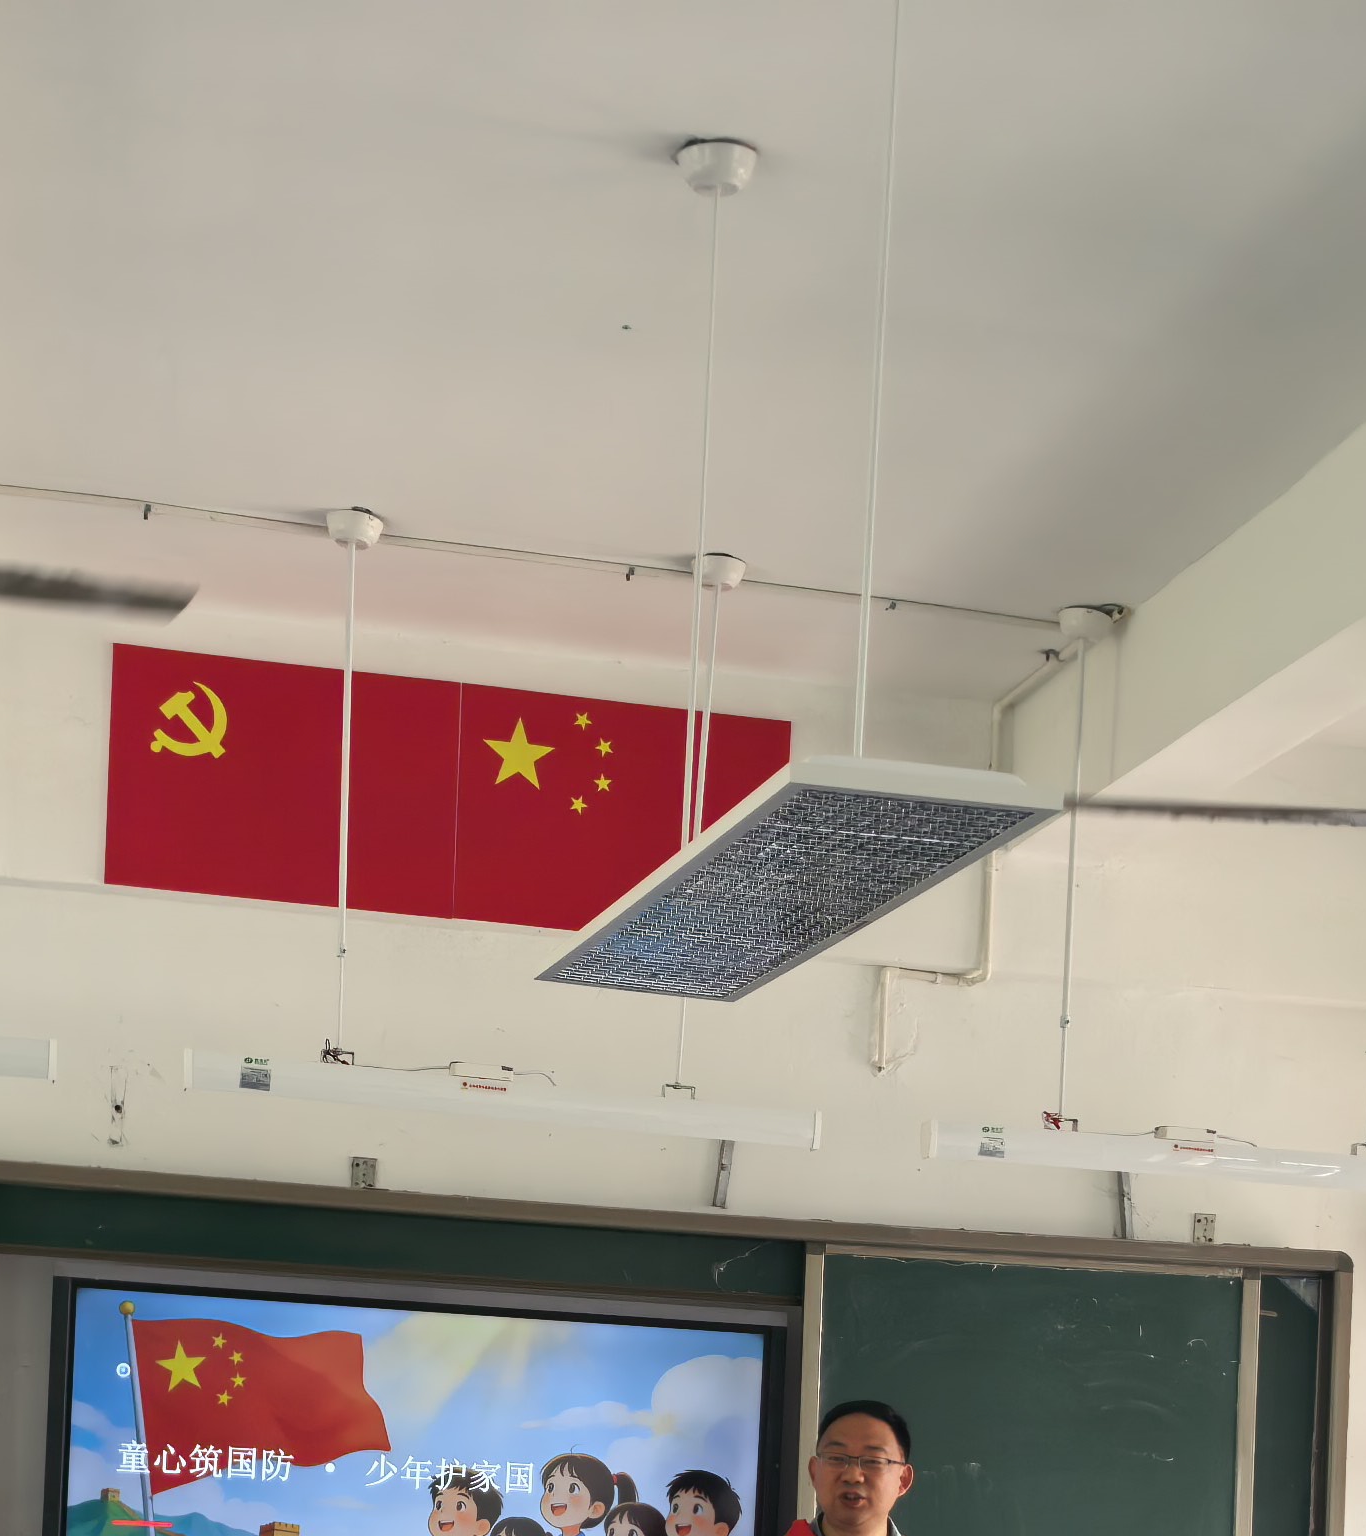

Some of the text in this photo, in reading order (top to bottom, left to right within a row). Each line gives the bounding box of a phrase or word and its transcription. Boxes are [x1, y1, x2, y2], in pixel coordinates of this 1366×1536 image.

[116, 1440, 295, 1483] 童心筑国防
[365, 1457, 535, 1495] 少年护家国
